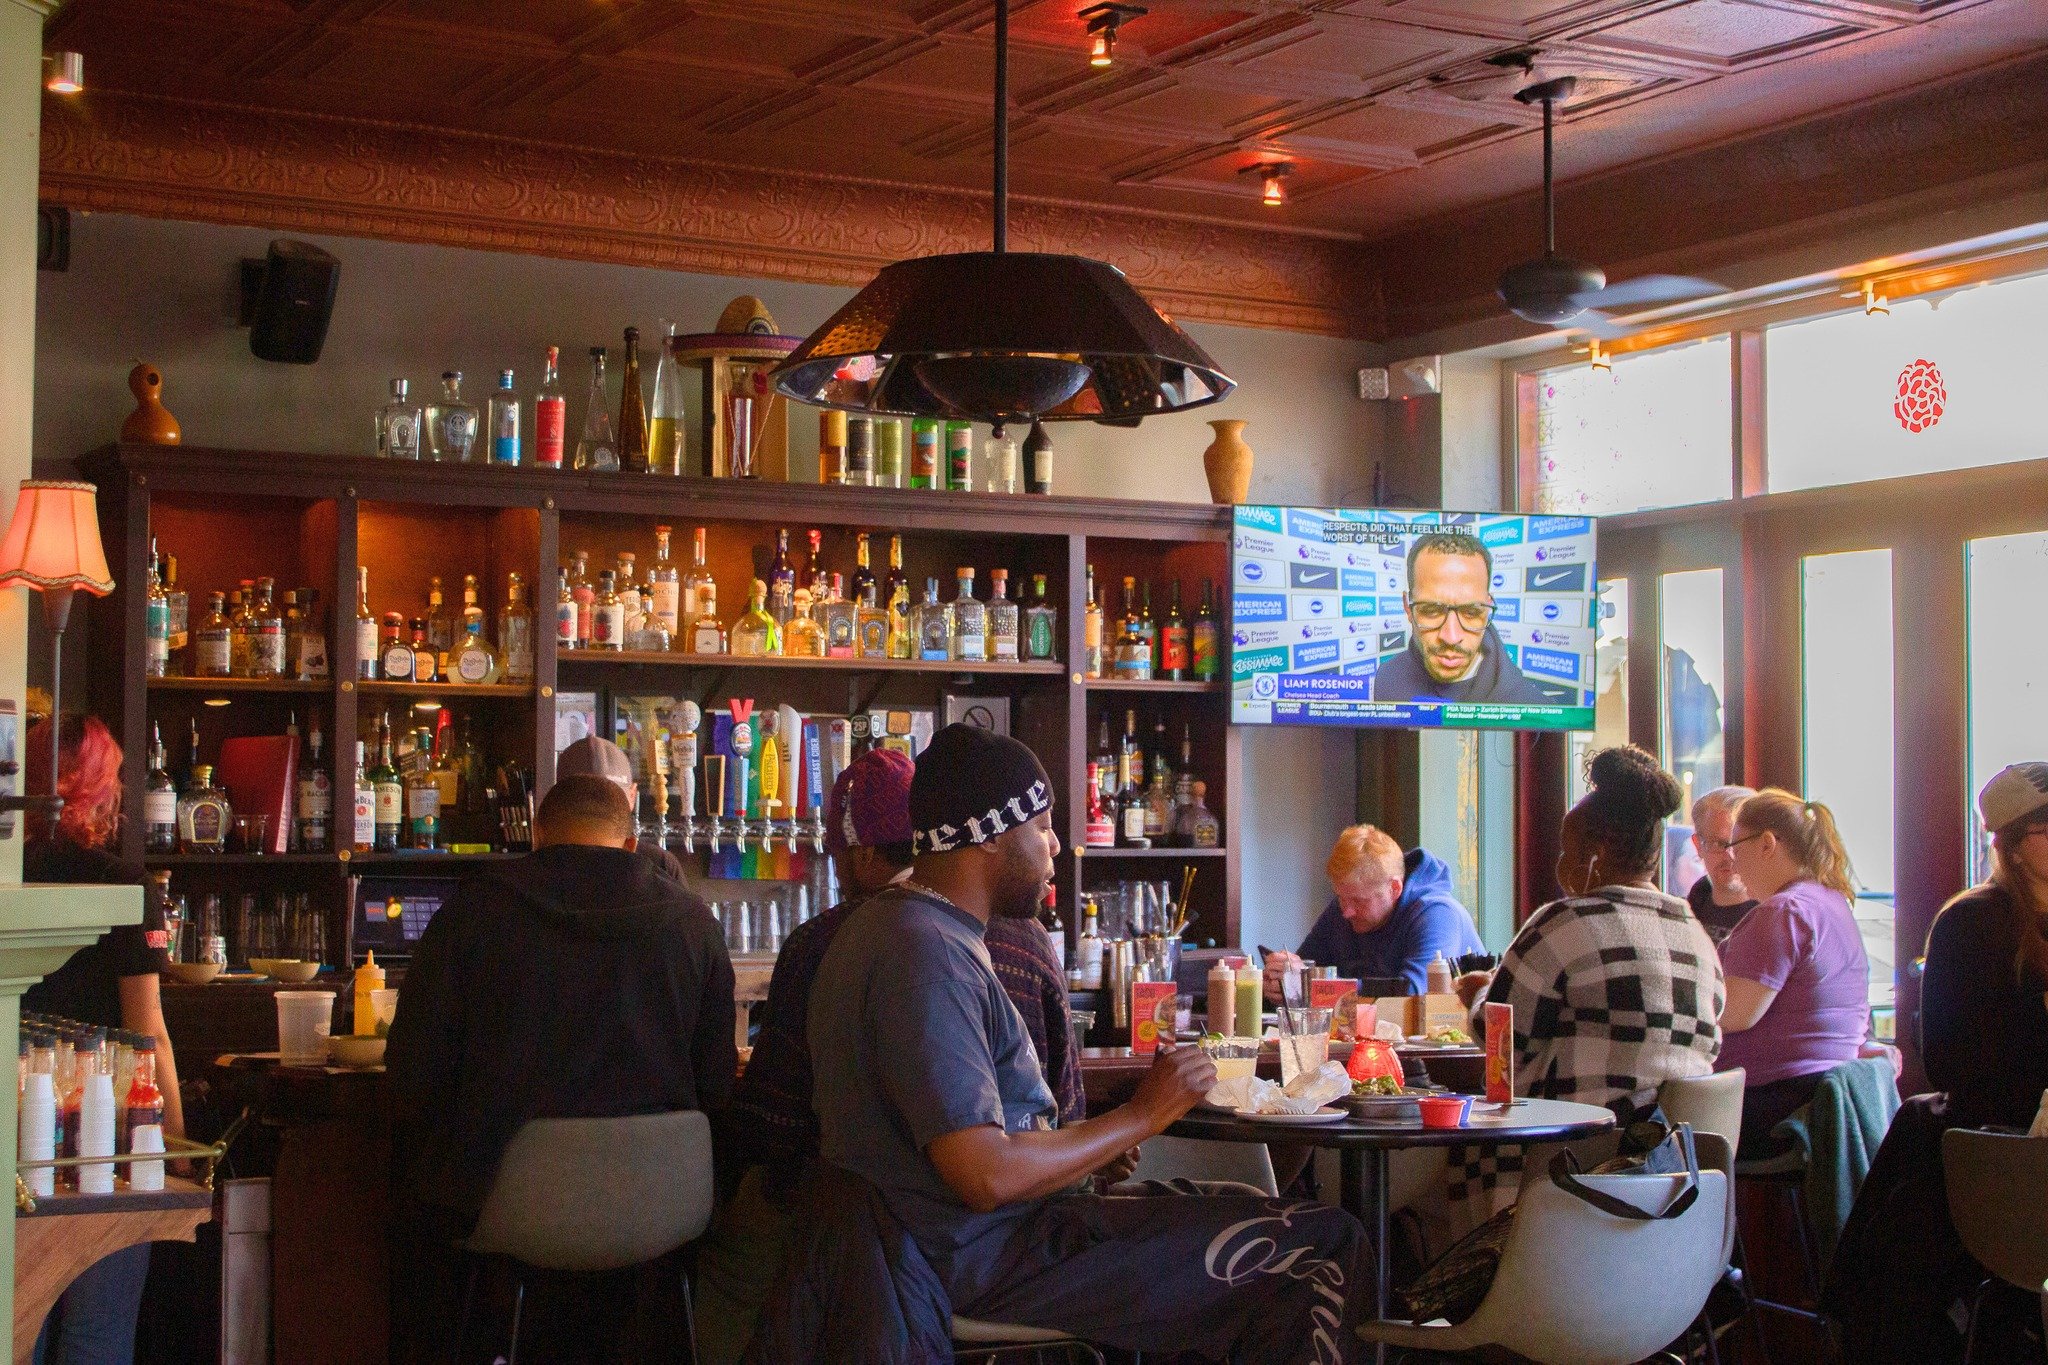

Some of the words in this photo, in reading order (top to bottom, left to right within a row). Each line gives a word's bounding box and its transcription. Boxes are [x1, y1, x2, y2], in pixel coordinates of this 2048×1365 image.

[1323, 522, 1369, 533] RESPECTS,
[1370, 524, 1385, 533] DID
[1388, 525, 1410, 533] THAT
[1412, 525, 1433, 534] FEEL
[1434, 526, 1453, 535] LIKE
[1455, 526, 1473, 536] THE
[1244, 535, 1274, 546] Premier
[1323, 533, 1354, 542] WORST
[1355, 534, 1367, 543] OF
[1370, 534, 1386, 543] THE
[1388, 535, 1400, 543] LO
[1245, 543, 1275, 553] League
[1311, 547, 1330, 556] Premier
[1549, 545, 1576, 553] Premier
[1311, 554, 1330, 562] League
[1549, 551, 1576, 560] League
[1234, 600, 1281, 609] MERICAN
[1234, 608, 1282, 617] EXPRESS
[1251, 629, 1279, 638] Premier
[1545, 632, 1570, 641] Premier
[1251, 636, 1279, 644] League
[1545, 638, 1570, 647] League
[1298, 645, 1336, 657] AMERICAN
[1527, 652, 1573, 668] AMERICAN
[1531, 660, 1574, 674] EXPRESS
[1284, 678, 1309, 689] LIAM
[1311, 678, 1363, 691] ROSENIOR
[1284, 691, 1306, 699] Chelsea
[1310, 702, 1349, 710] Bournemouth
[1357, 703, 1375, 711] Leeds
[1376, 704, 1396, 712] United
[1446, 705, 1459, 713] PGA
[1528, 707, 1540, 715] New
[375, 783, 402, 794] AMESON
